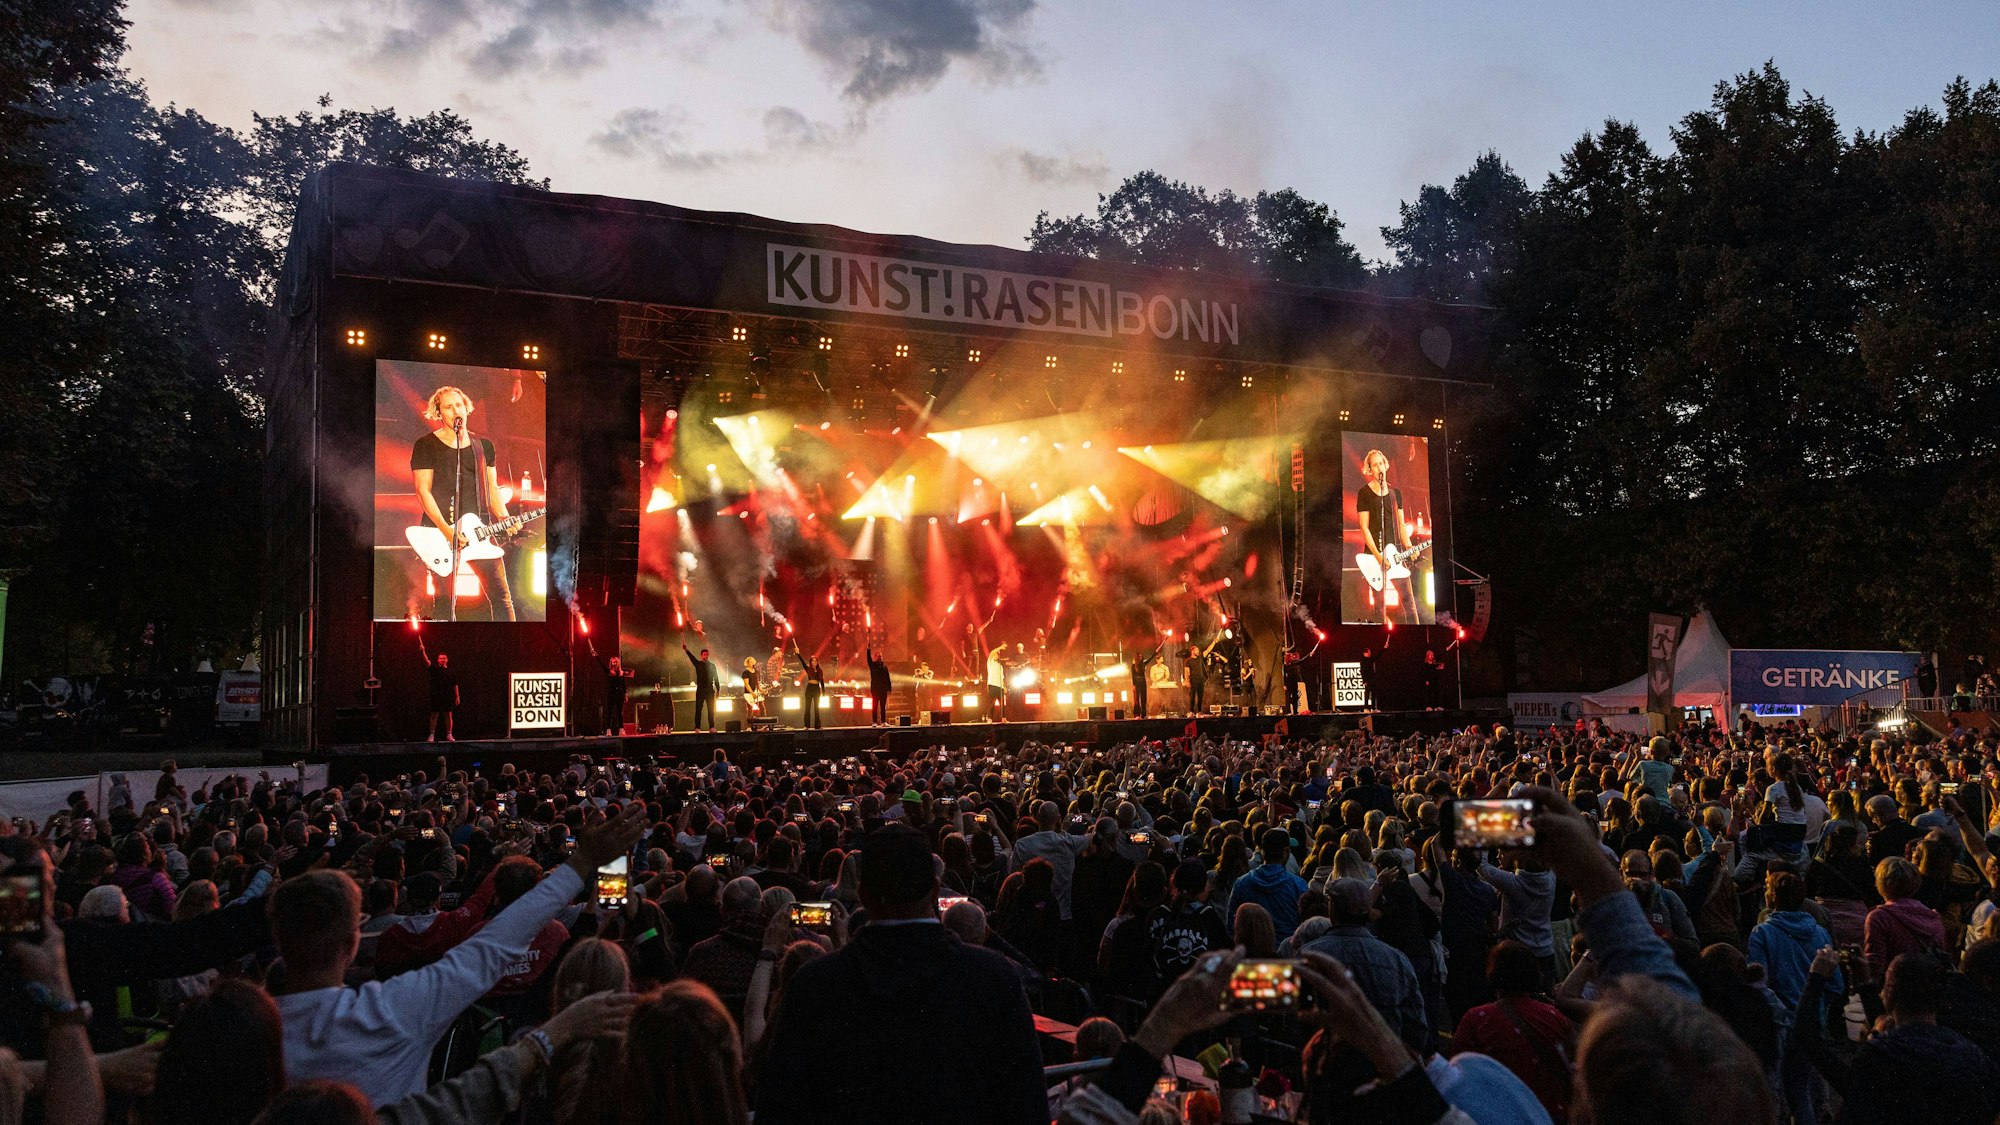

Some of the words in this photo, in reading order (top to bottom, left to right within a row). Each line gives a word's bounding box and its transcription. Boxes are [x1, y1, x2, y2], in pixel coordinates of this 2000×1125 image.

[1116, 290, 1239, 345] BONN
[1336, 668, 1363, 679] KUNS
[1761, 663, 1899, 690] GETRÄNKE
[514, 680, 562, 694] KUNST!
[1338, 678, 1365, 689] RASE
[516, 693, 559, 707] RASEN
[1338, 691, 1363, 702] BON
[515, 709, 561, 723] BONN
